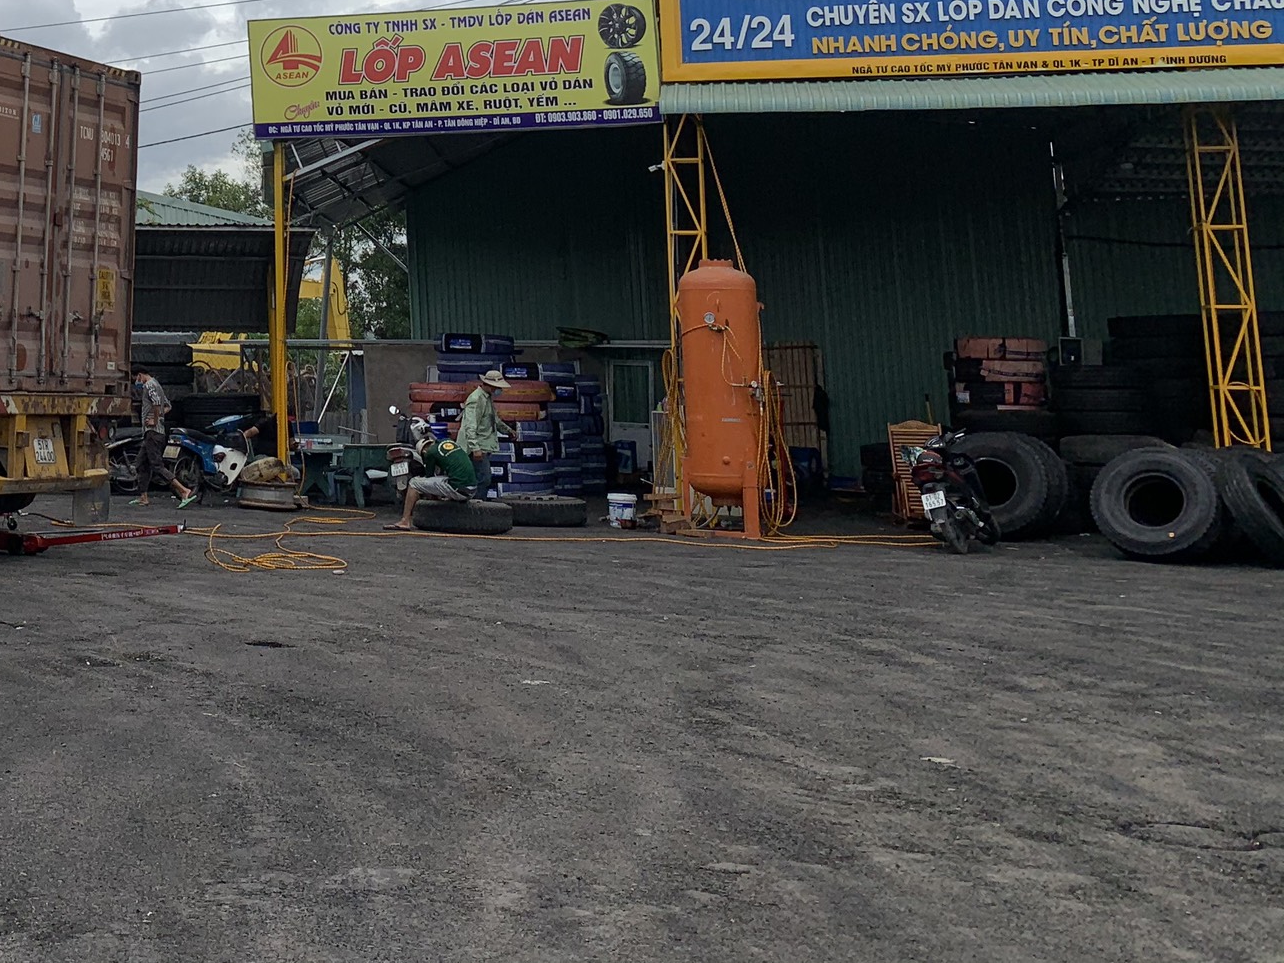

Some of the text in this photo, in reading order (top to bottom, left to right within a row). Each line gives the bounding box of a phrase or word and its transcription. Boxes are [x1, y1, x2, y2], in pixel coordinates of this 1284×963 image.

[328, 20, 361, 35] CÔNG
[365, 21, 380, 34] TY
[384, 19, 418, 33] TNHH
[422, 18, 437, 30] SX
[449, 14, 484, 29] TMDV
[489, 8, 512, 26] LỐP
[517, 8, 544, 25] DÁN
[549, 8, 591, 23] ASEAN
[902, 2, 931, 23] SX
[689, 14, 795, 51] 24/24
[811, 34, 897, 54] NHANH
[1176, 19, 1273, 46] LƯỢNG
[338, 33, 585, 85] LỐP ASEAN
[875, 65, 889, 74] TƯ
[891, 65, 910, 73] CAO
[914, 62, 933, 73] TỐC
[955, 61, 990, 72] PHƯỚC
[993, 60, 1013, 70] TÂN
[1016, 61, 1038, 71] VẠN
[1041, 59, 1049, 68] &
[1053, 59, 1066, 68] QL
[1069, 59, 1081, 68] 1K
[1092, 58, 1104, 67] TP
[1122, 57, 1139, 66] AN
[1189, 55, 1227, 64] DƯƠNG
[276, 71, 309, 80] ASEAN
[325, 90, 355, 101] MUA
[359, 87, 388, 100] BÁN
[402, 86, 437, 97] TRAO
[441, 81, 465, 96] ĐỔI
[470, 81, 498, 95] CÁC
[503, 81, 535, 95] LOẠI
[540, 77, 558, 91] VỎ
[563, 77, 593, 90] DÁN
[327, 102, 344, 116] VỎ
[349, 102, 375, 115] MỚI
[389, 101, 412, 114] CŨ,
[416, 100, 452, 113] MÂM
[456, 100, 479, 111] XE,
[483, 97, 523, 111] RUỘT,
[527, 93, 559, 108] YẾM
[301, 123, 312, 132] CAO
[313, 121, 324, 132] TỐC
[335, 120, 354, 131] PHƯỚC
[355, 120, 367, 130] TÂN
[367, 120, 379, 131] VẠN
[384, 121, 391, 130] QL
[402, 121, 410, 129] KP
[412, 119, 423, 128] TÂN
[424, 120, 433, 128] AN
[444, 118, 455, 127] TÂN
[474, 117, 488, 127] HIỆP
[548, 110, 597, 122] 0903.903.860
[603, 108, 653, 120] 0901.029.650
[80, 125, 94, 141] TCNU
